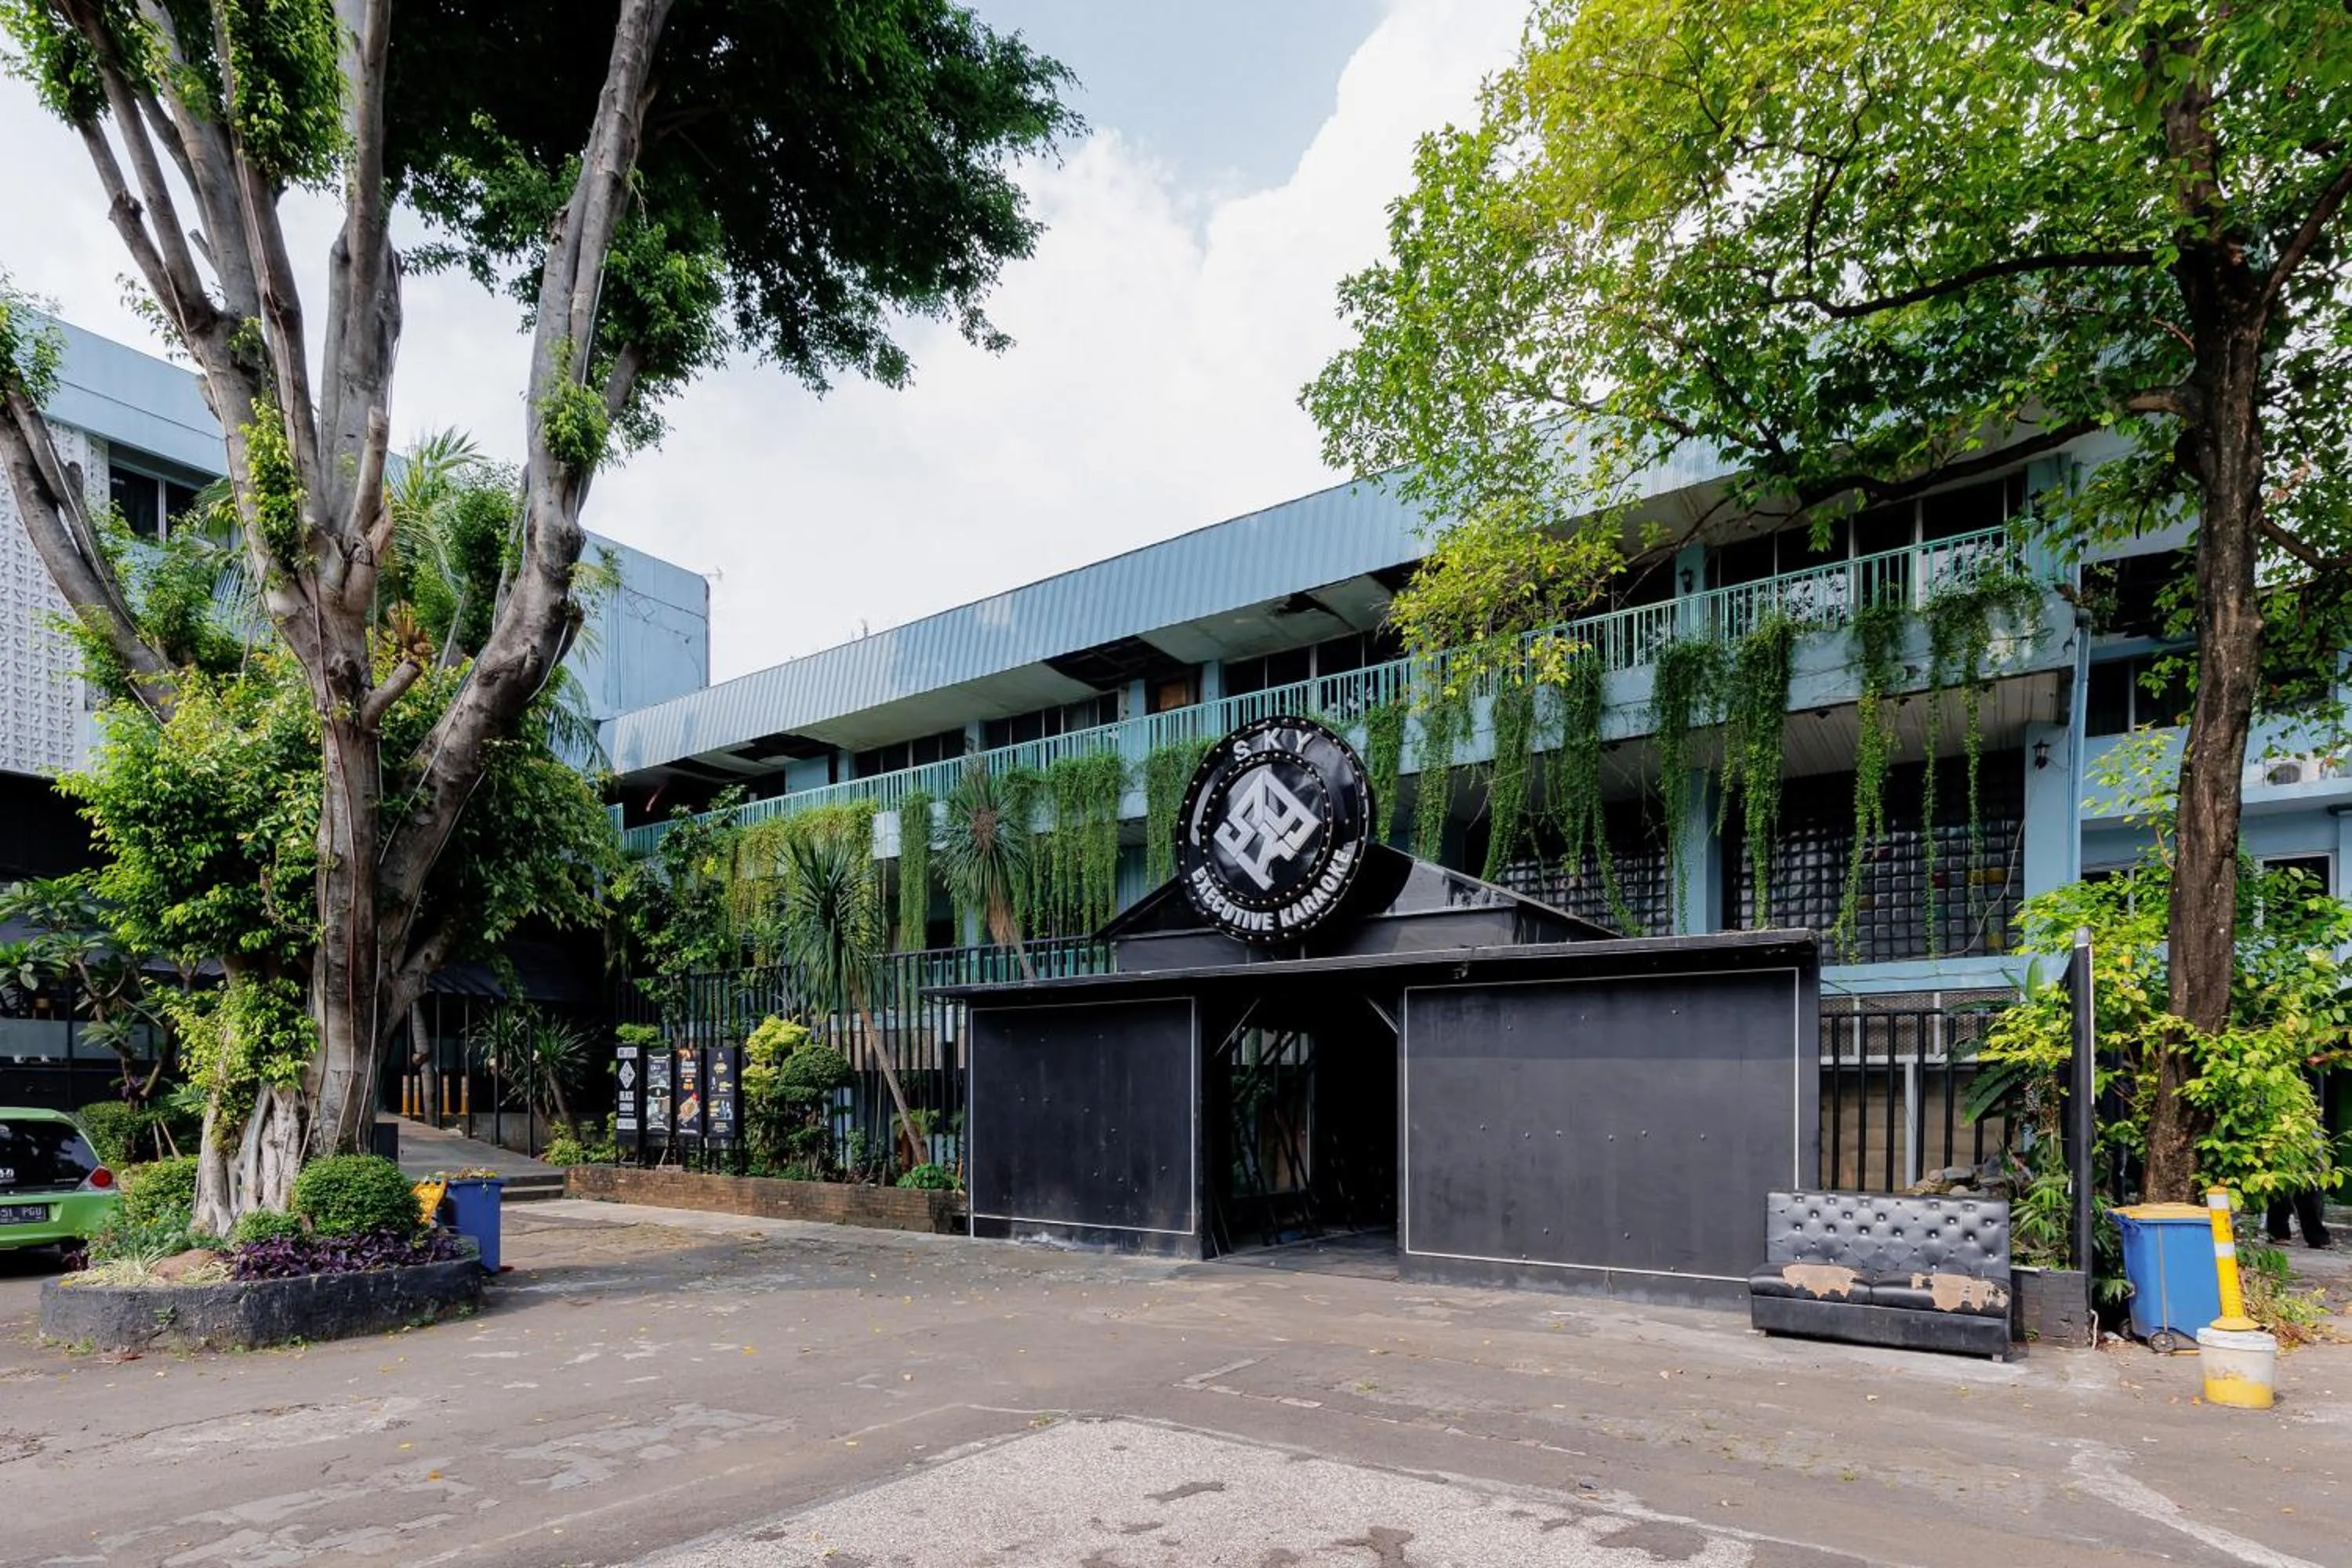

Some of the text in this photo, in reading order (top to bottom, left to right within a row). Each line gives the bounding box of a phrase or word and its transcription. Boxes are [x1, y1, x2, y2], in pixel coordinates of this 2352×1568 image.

[1233, 727, 1313, 761] SKY
[1191, 849, 1352, 931] EXECUTIVE KARAOKE
